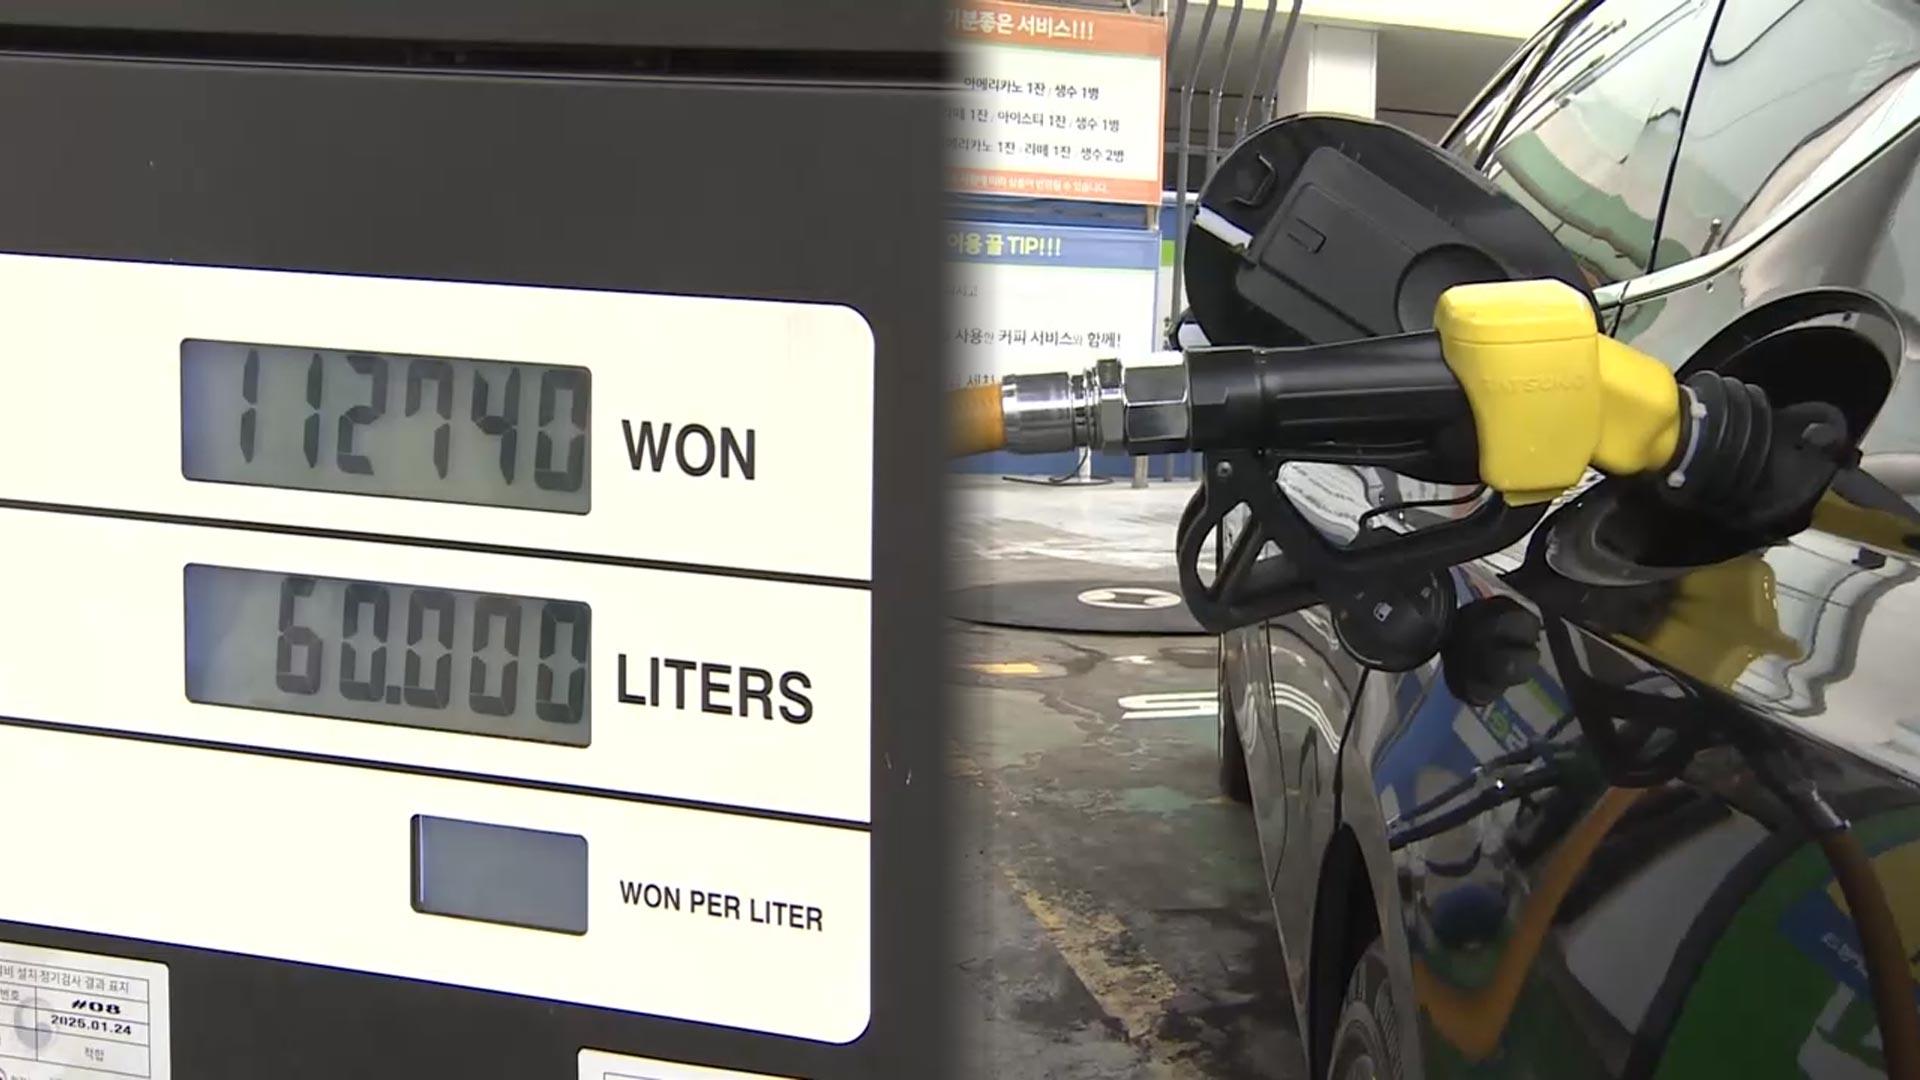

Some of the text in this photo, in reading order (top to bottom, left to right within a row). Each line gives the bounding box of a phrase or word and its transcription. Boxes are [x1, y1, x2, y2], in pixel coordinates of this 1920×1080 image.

[1017, 15, 1094, 41] 서비스!!!
[963, 76, 1099, 101] 아메리카노 1잔 생수 1병
[970, 109, 988, 123] 1잔
[997, 110, 1044, 127] 아이스티
[1049, 114, 1066, 129] 1잔
[1075, 117, 1098, 131] 생수
[1103, 119, 1120, 133] 1병
[998, 141, 1016, 155] 1잔
[1054, 145, 1071, 160] 1잔
[1081, 147, 1102, 161] 생수
[1105, 149, 1124, 163] 2병
[947, 232, 982, 256] 이용
[1007, 236, 1061, 257] TIP!!!
[998, 329, 1027, 345] 커피
[1030, 330, 1083, 346] 서비스와
[1087, 332, 1121, 348] 함께!
[240, 349, 586, 492] 112740
[622, 419, 756, 480] WON
[276, 574, 586, 724] 60.000
[616, 653, 814, 724] LITERS
[619, 880, 823, 932] WON PER LITER
[0, 964, 130, 994] 비 설치 정기검사 결과 표지
[51, 1014, 132, 1036] 2025.01.24
